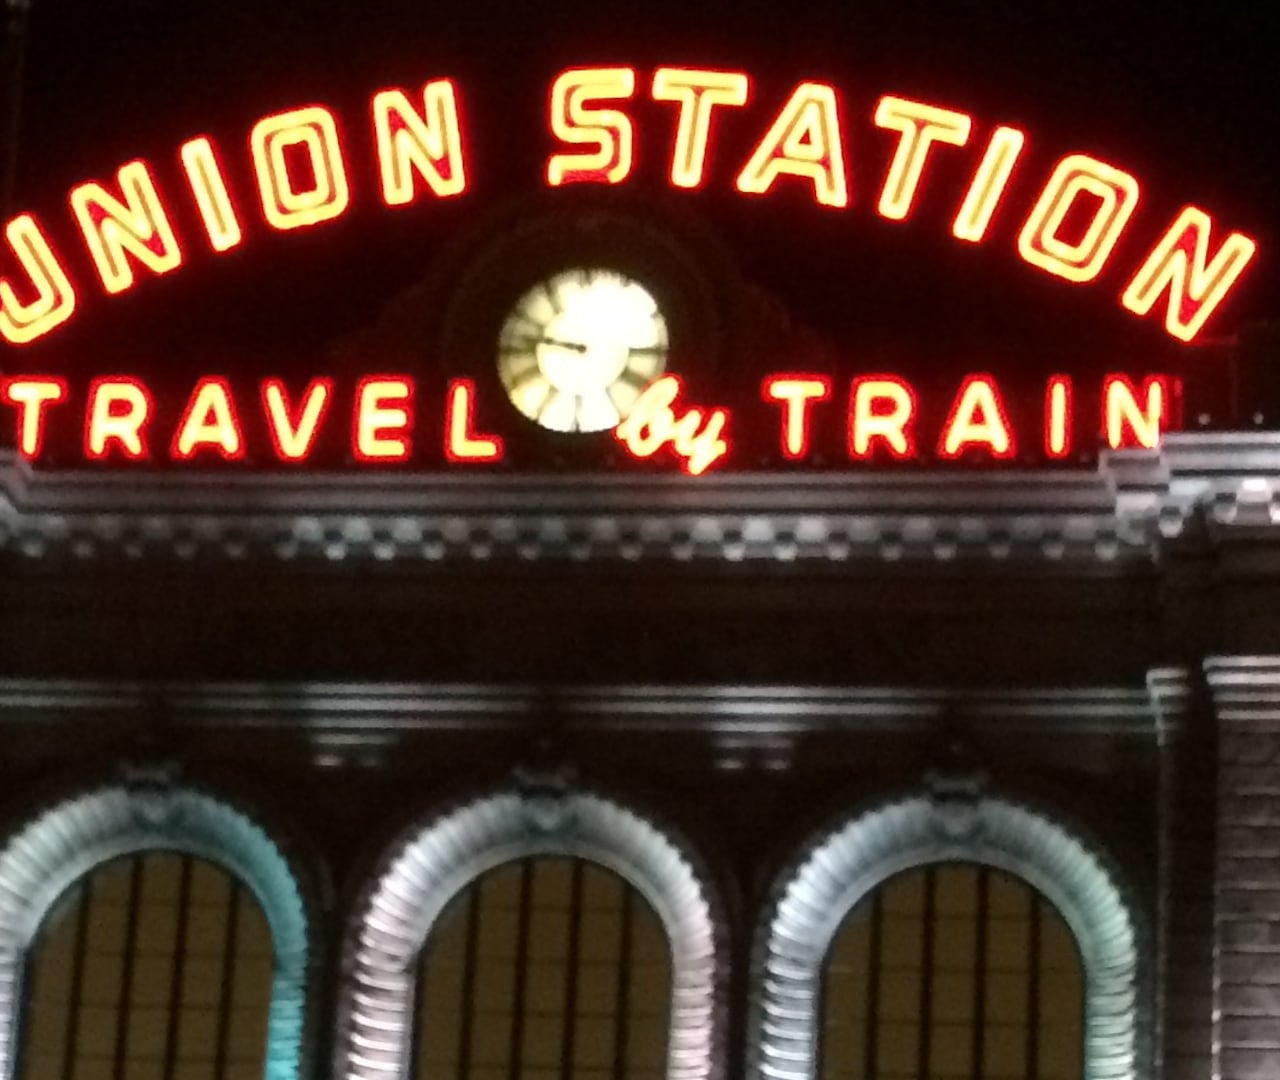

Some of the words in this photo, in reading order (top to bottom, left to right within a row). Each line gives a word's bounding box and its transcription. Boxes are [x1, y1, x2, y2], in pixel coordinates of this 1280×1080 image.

[545, 64, 1258, 344] STATION
[3, 378, 502, 460] TRAVEL
[615, 374, 728, 475] by
[766, 376, 1170, 453] TRAIN
